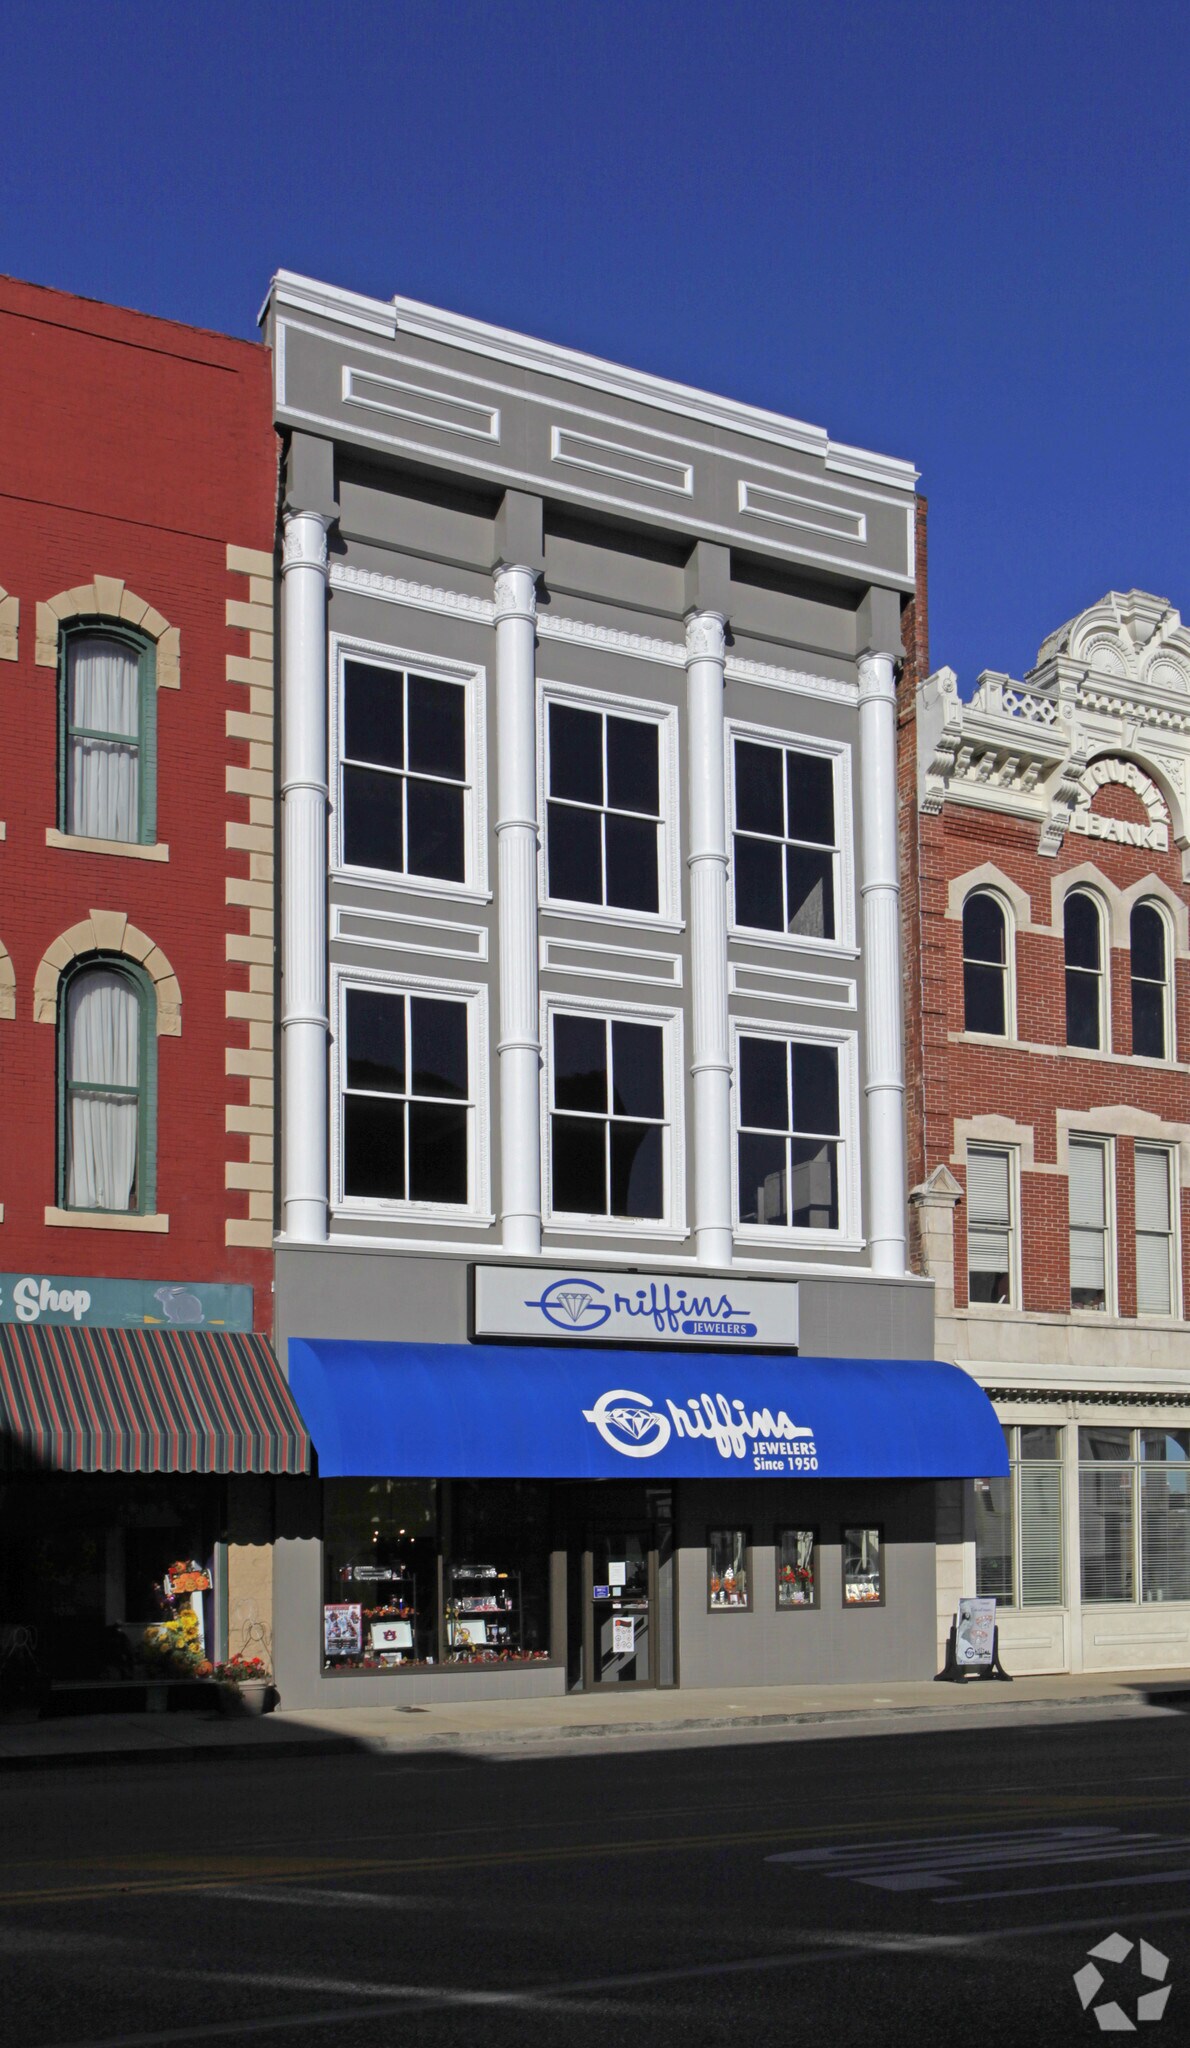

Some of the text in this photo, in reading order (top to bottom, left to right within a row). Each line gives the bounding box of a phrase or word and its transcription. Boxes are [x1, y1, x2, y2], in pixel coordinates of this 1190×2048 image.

[1088, 813, 1156, 849] BANK
[13, 1277, 91, 1322] Shop
[524, 1278, 751, 1332] Griffins
[692, 1322, 747, 1335] JEWELERS
[582, 1389, 814, 1459] Griffins
[752, 1442, 817, 1456] JEWELERS
[754, 1456, 819, 1471] Since 1950
